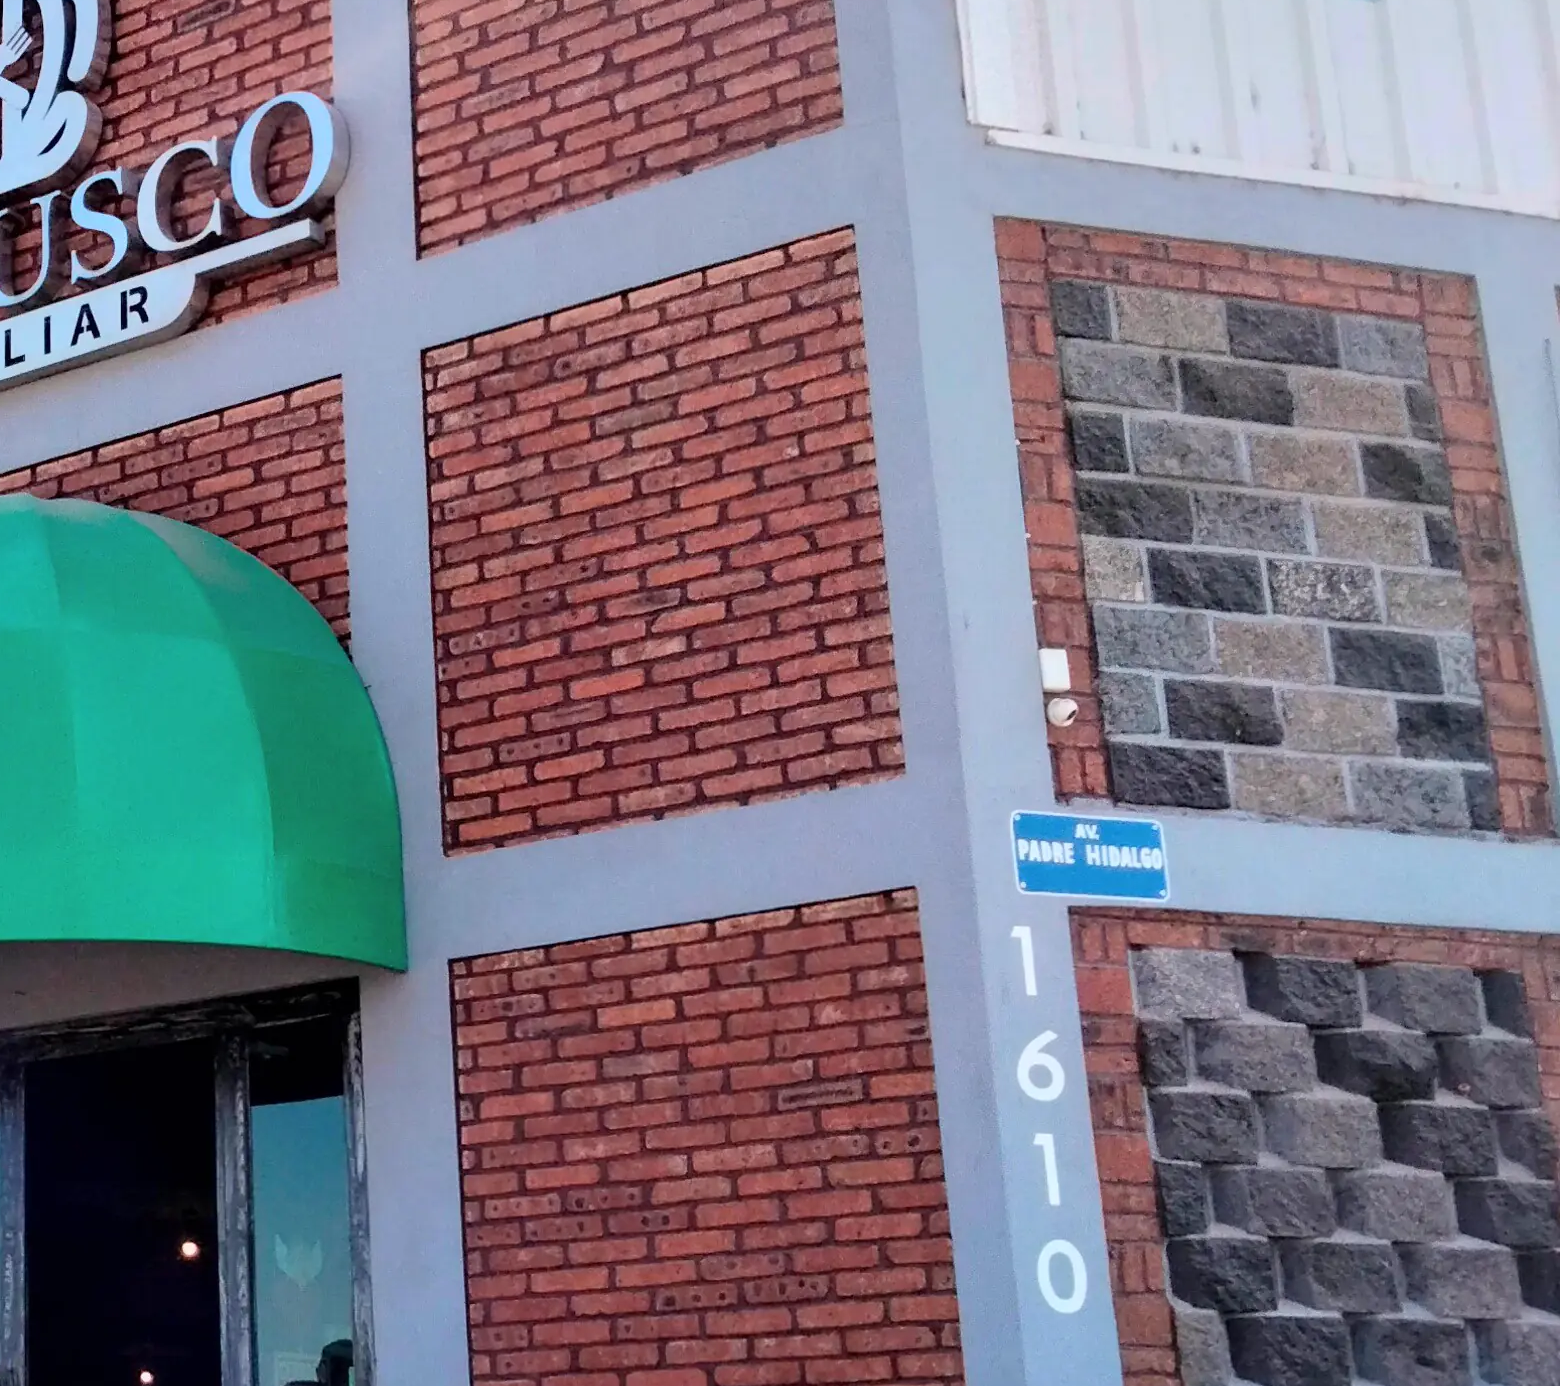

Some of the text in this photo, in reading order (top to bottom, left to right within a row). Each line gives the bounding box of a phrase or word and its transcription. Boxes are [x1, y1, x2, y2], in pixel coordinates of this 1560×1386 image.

[1075, 824, 1100, 840] AV.
[1017, 839, 1162, 870] PADRE HIDALGO
[1010, 925, 1088, 1314] 1610
